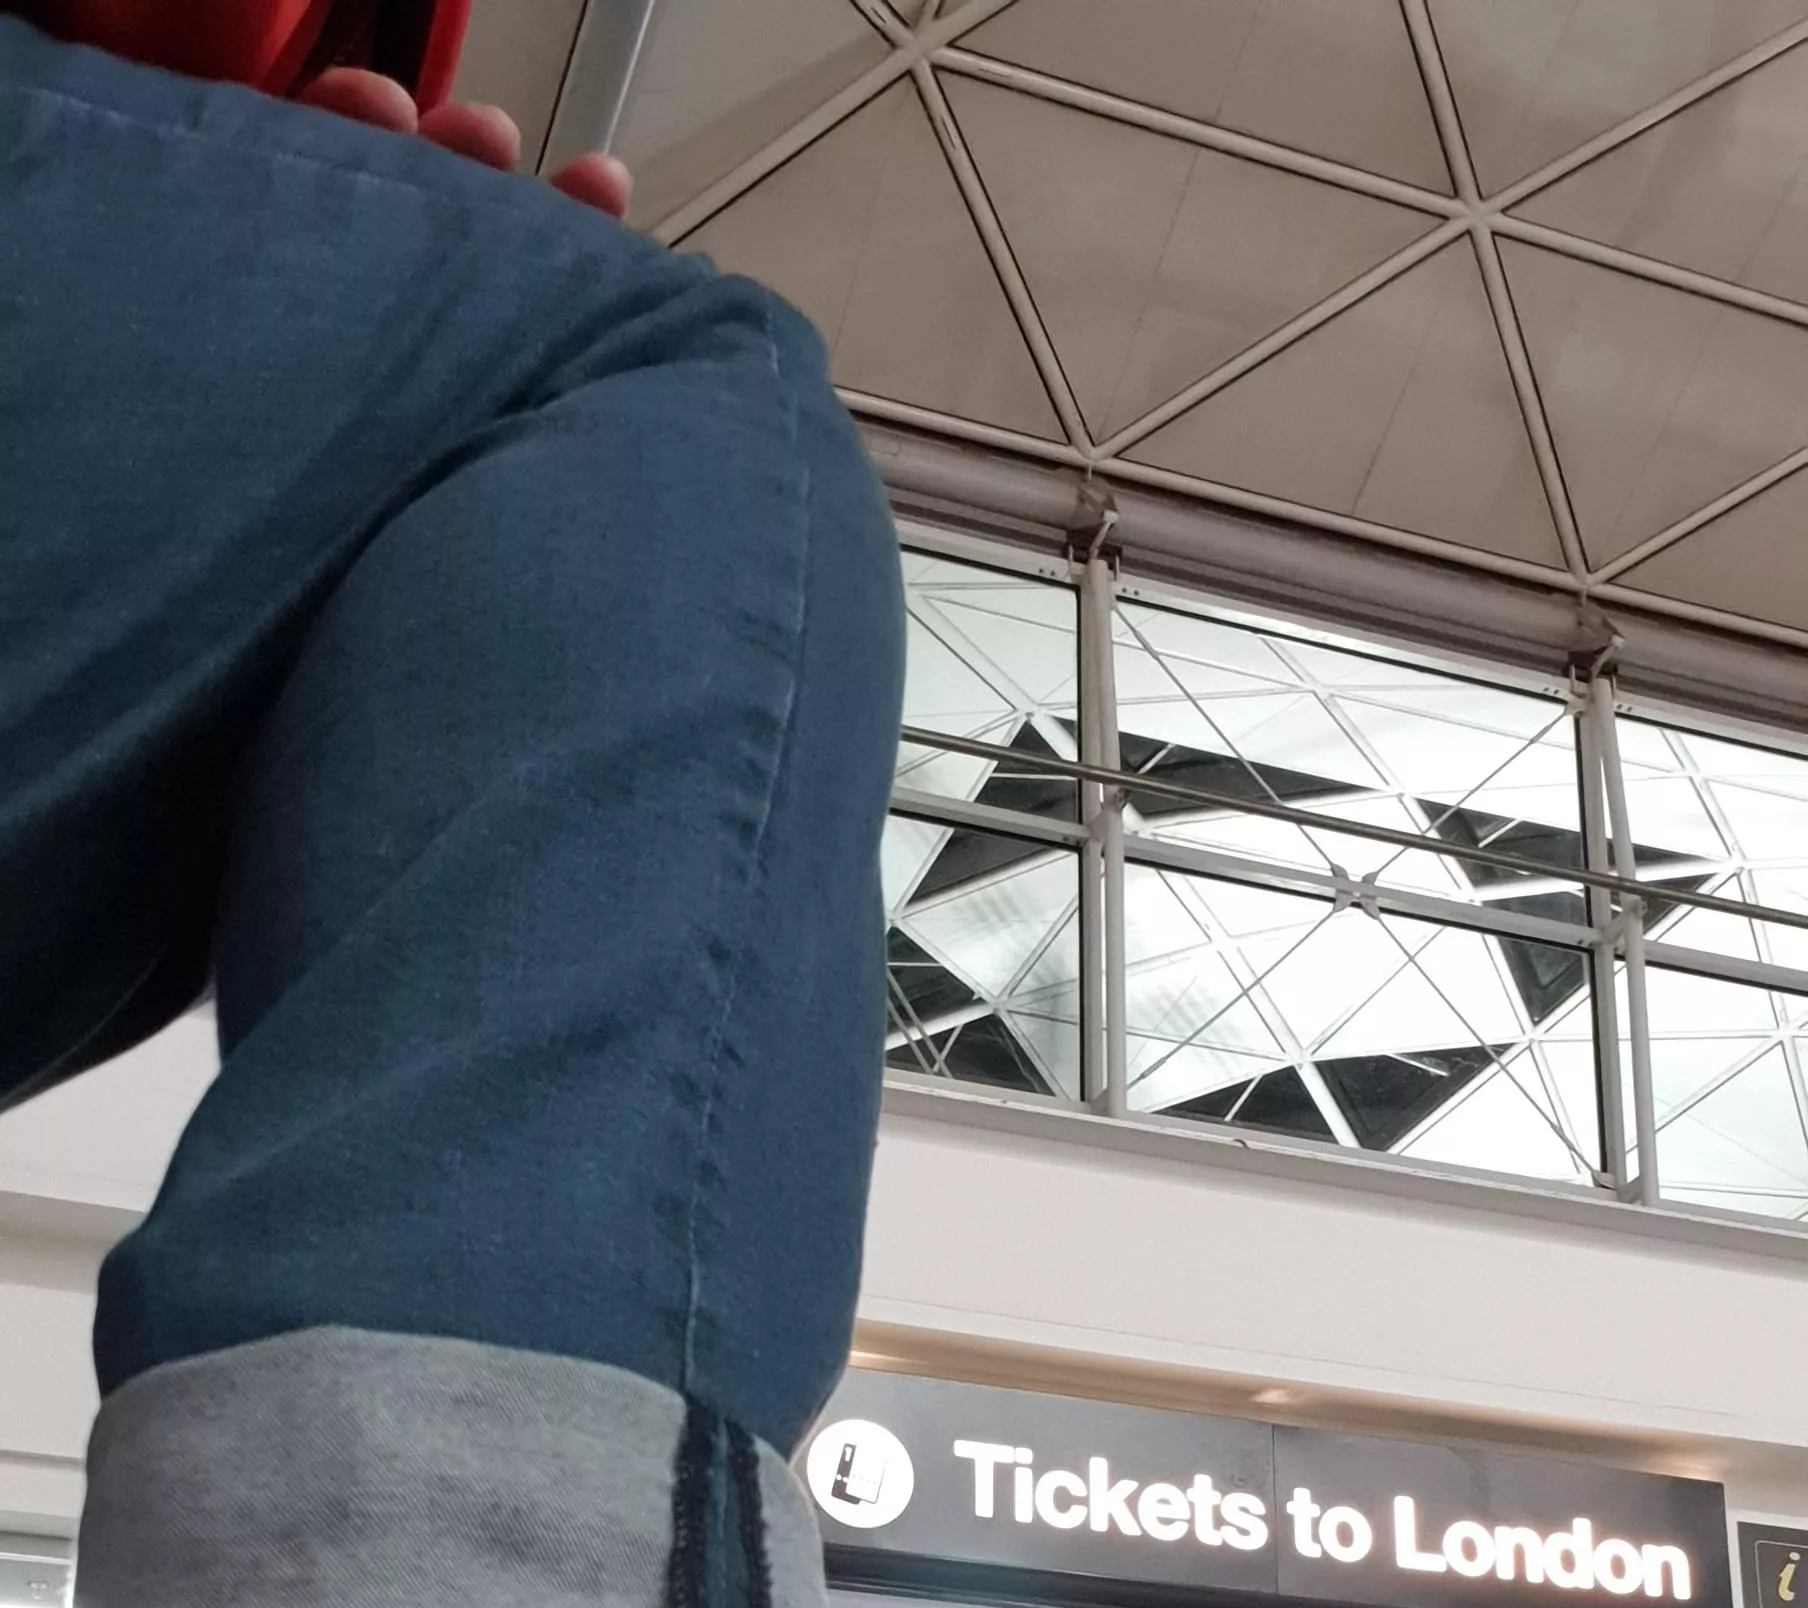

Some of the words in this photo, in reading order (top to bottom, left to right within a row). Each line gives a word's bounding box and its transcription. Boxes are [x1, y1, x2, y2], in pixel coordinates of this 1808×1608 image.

[954, 1439, 1269, 1551] Tickets
[1287, 1488, 1372, 1562] to
[1395, 1496, 1692, 1600] London
